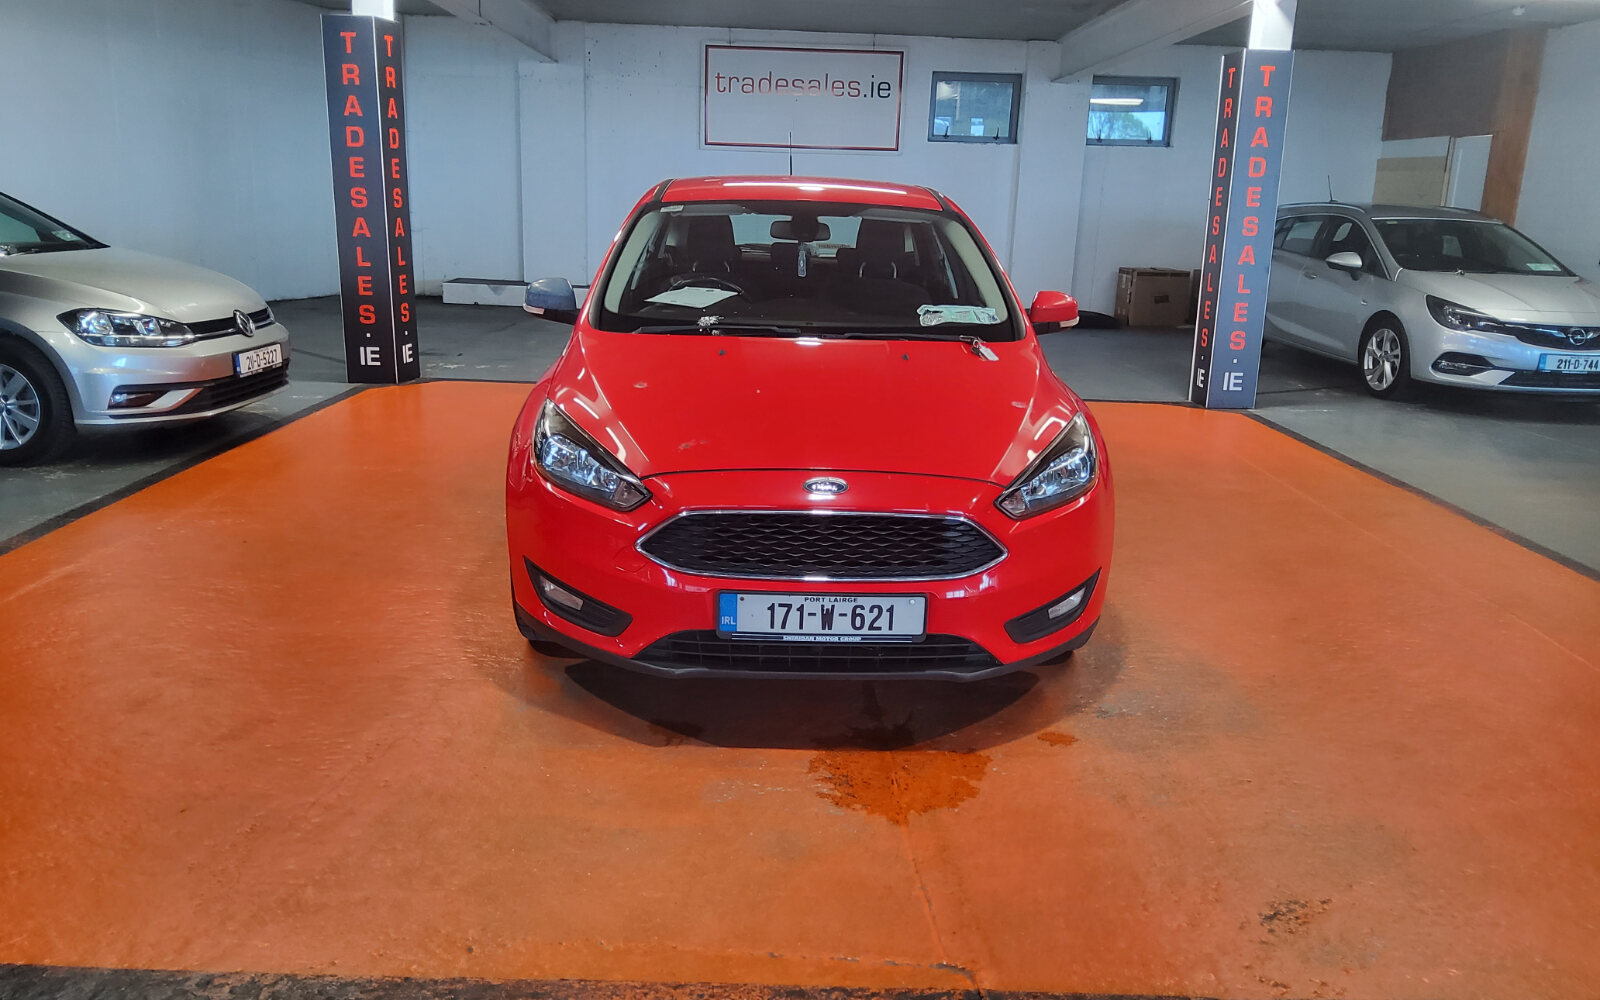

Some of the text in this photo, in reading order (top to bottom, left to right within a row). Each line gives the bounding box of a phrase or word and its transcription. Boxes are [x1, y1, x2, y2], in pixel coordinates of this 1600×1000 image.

[715, 71, 891, 98] tradesales.ie
[1557, 359, 1599, 369] 211-D-744
[721, 616, 736, 625] IRL
[767, 602, 894, 631] 171-W-621
